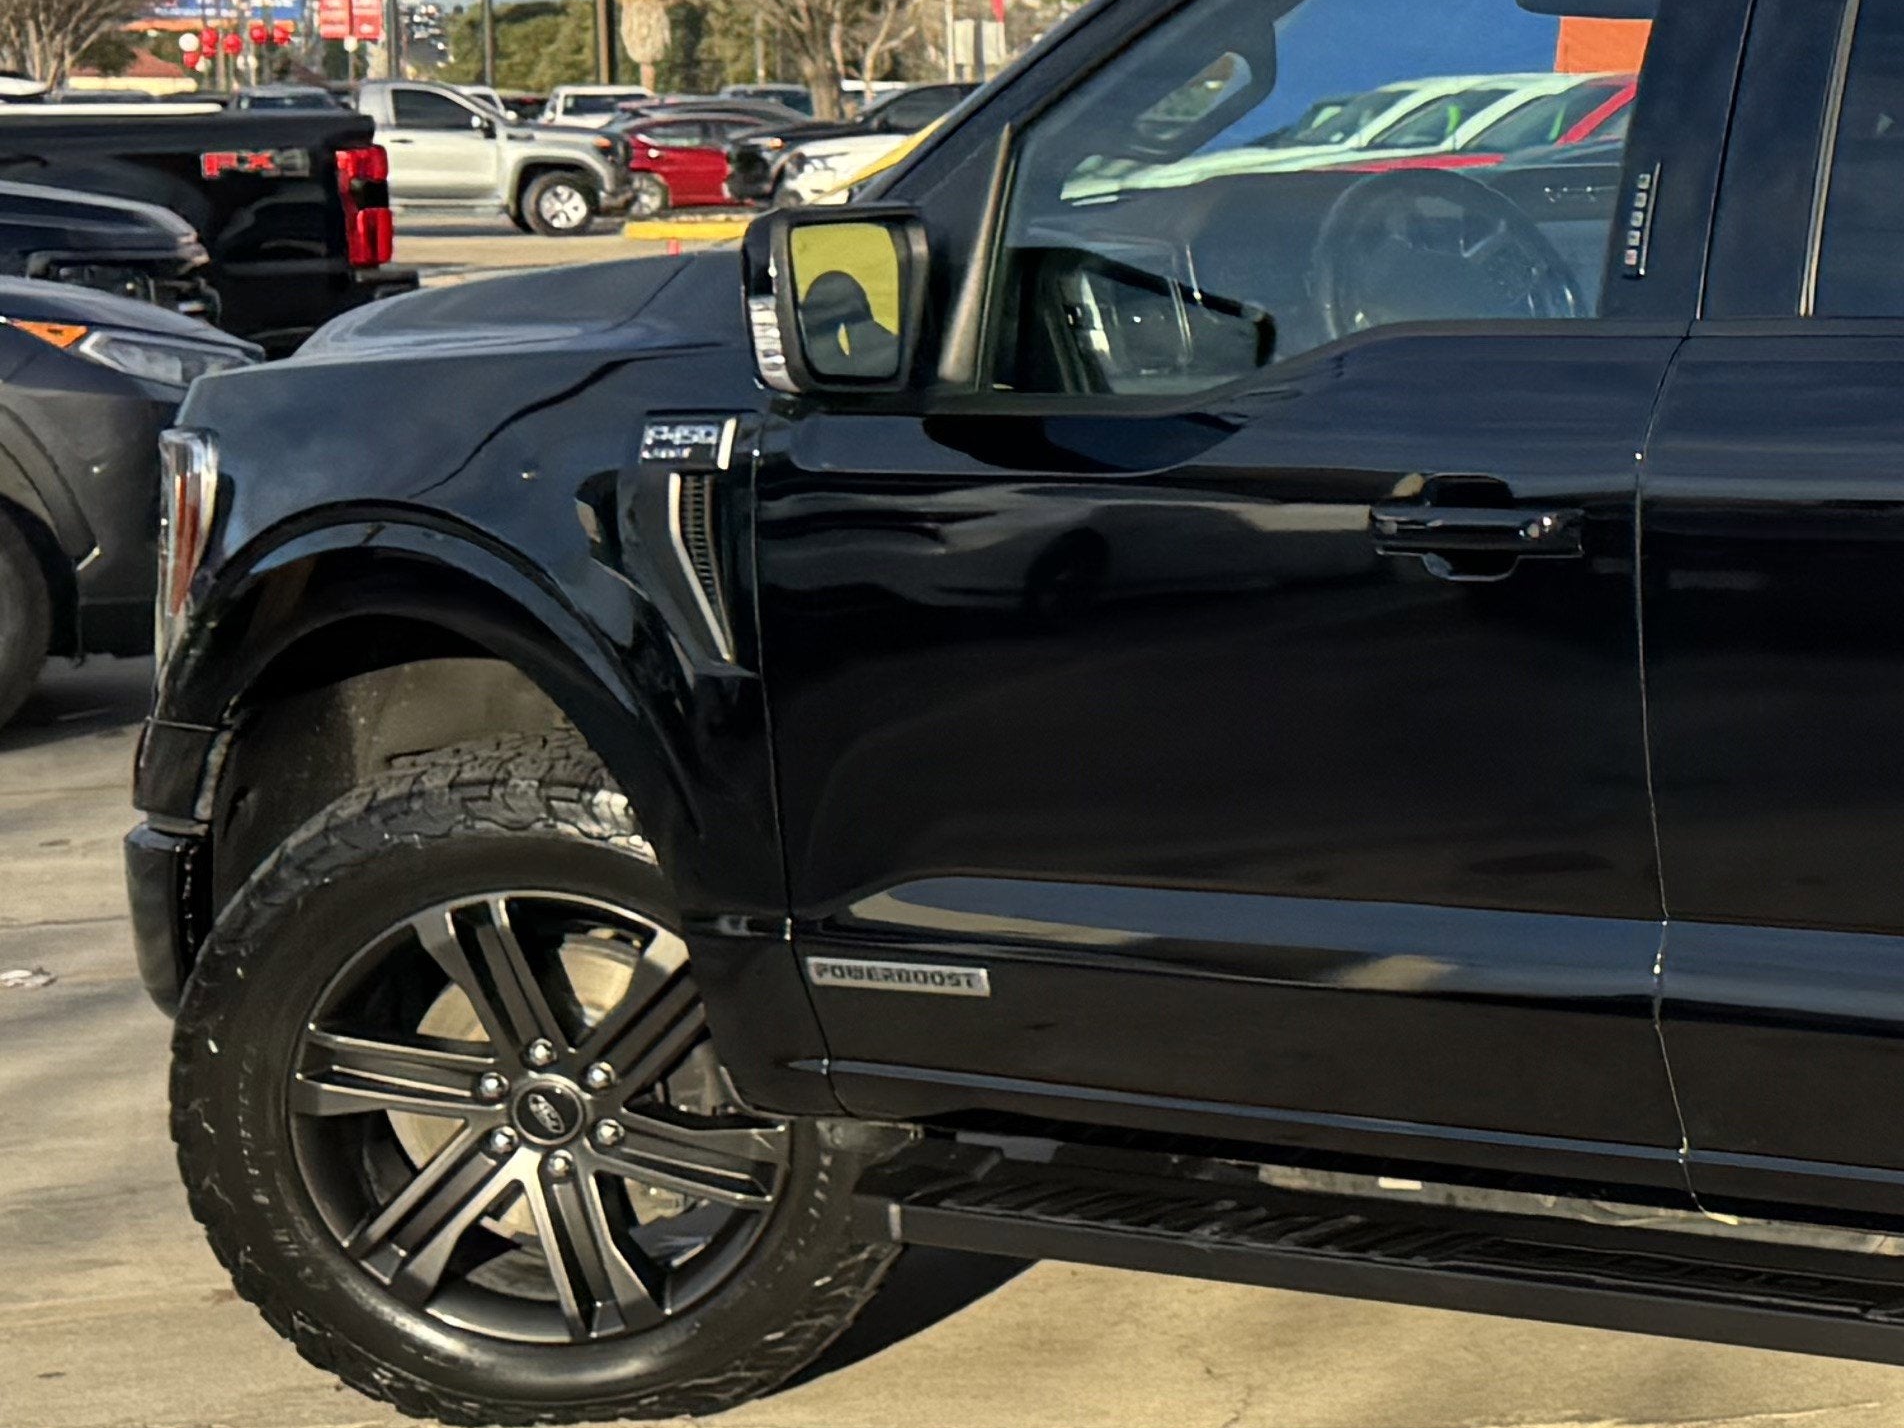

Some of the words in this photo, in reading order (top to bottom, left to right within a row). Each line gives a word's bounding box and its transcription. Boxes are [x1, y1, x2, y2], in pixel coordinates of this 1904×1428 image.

[201, 150, 310, 178] FX4
[645, 425, 719, 444] F-150
[813, 961, 976, 989] POWERBOOST
